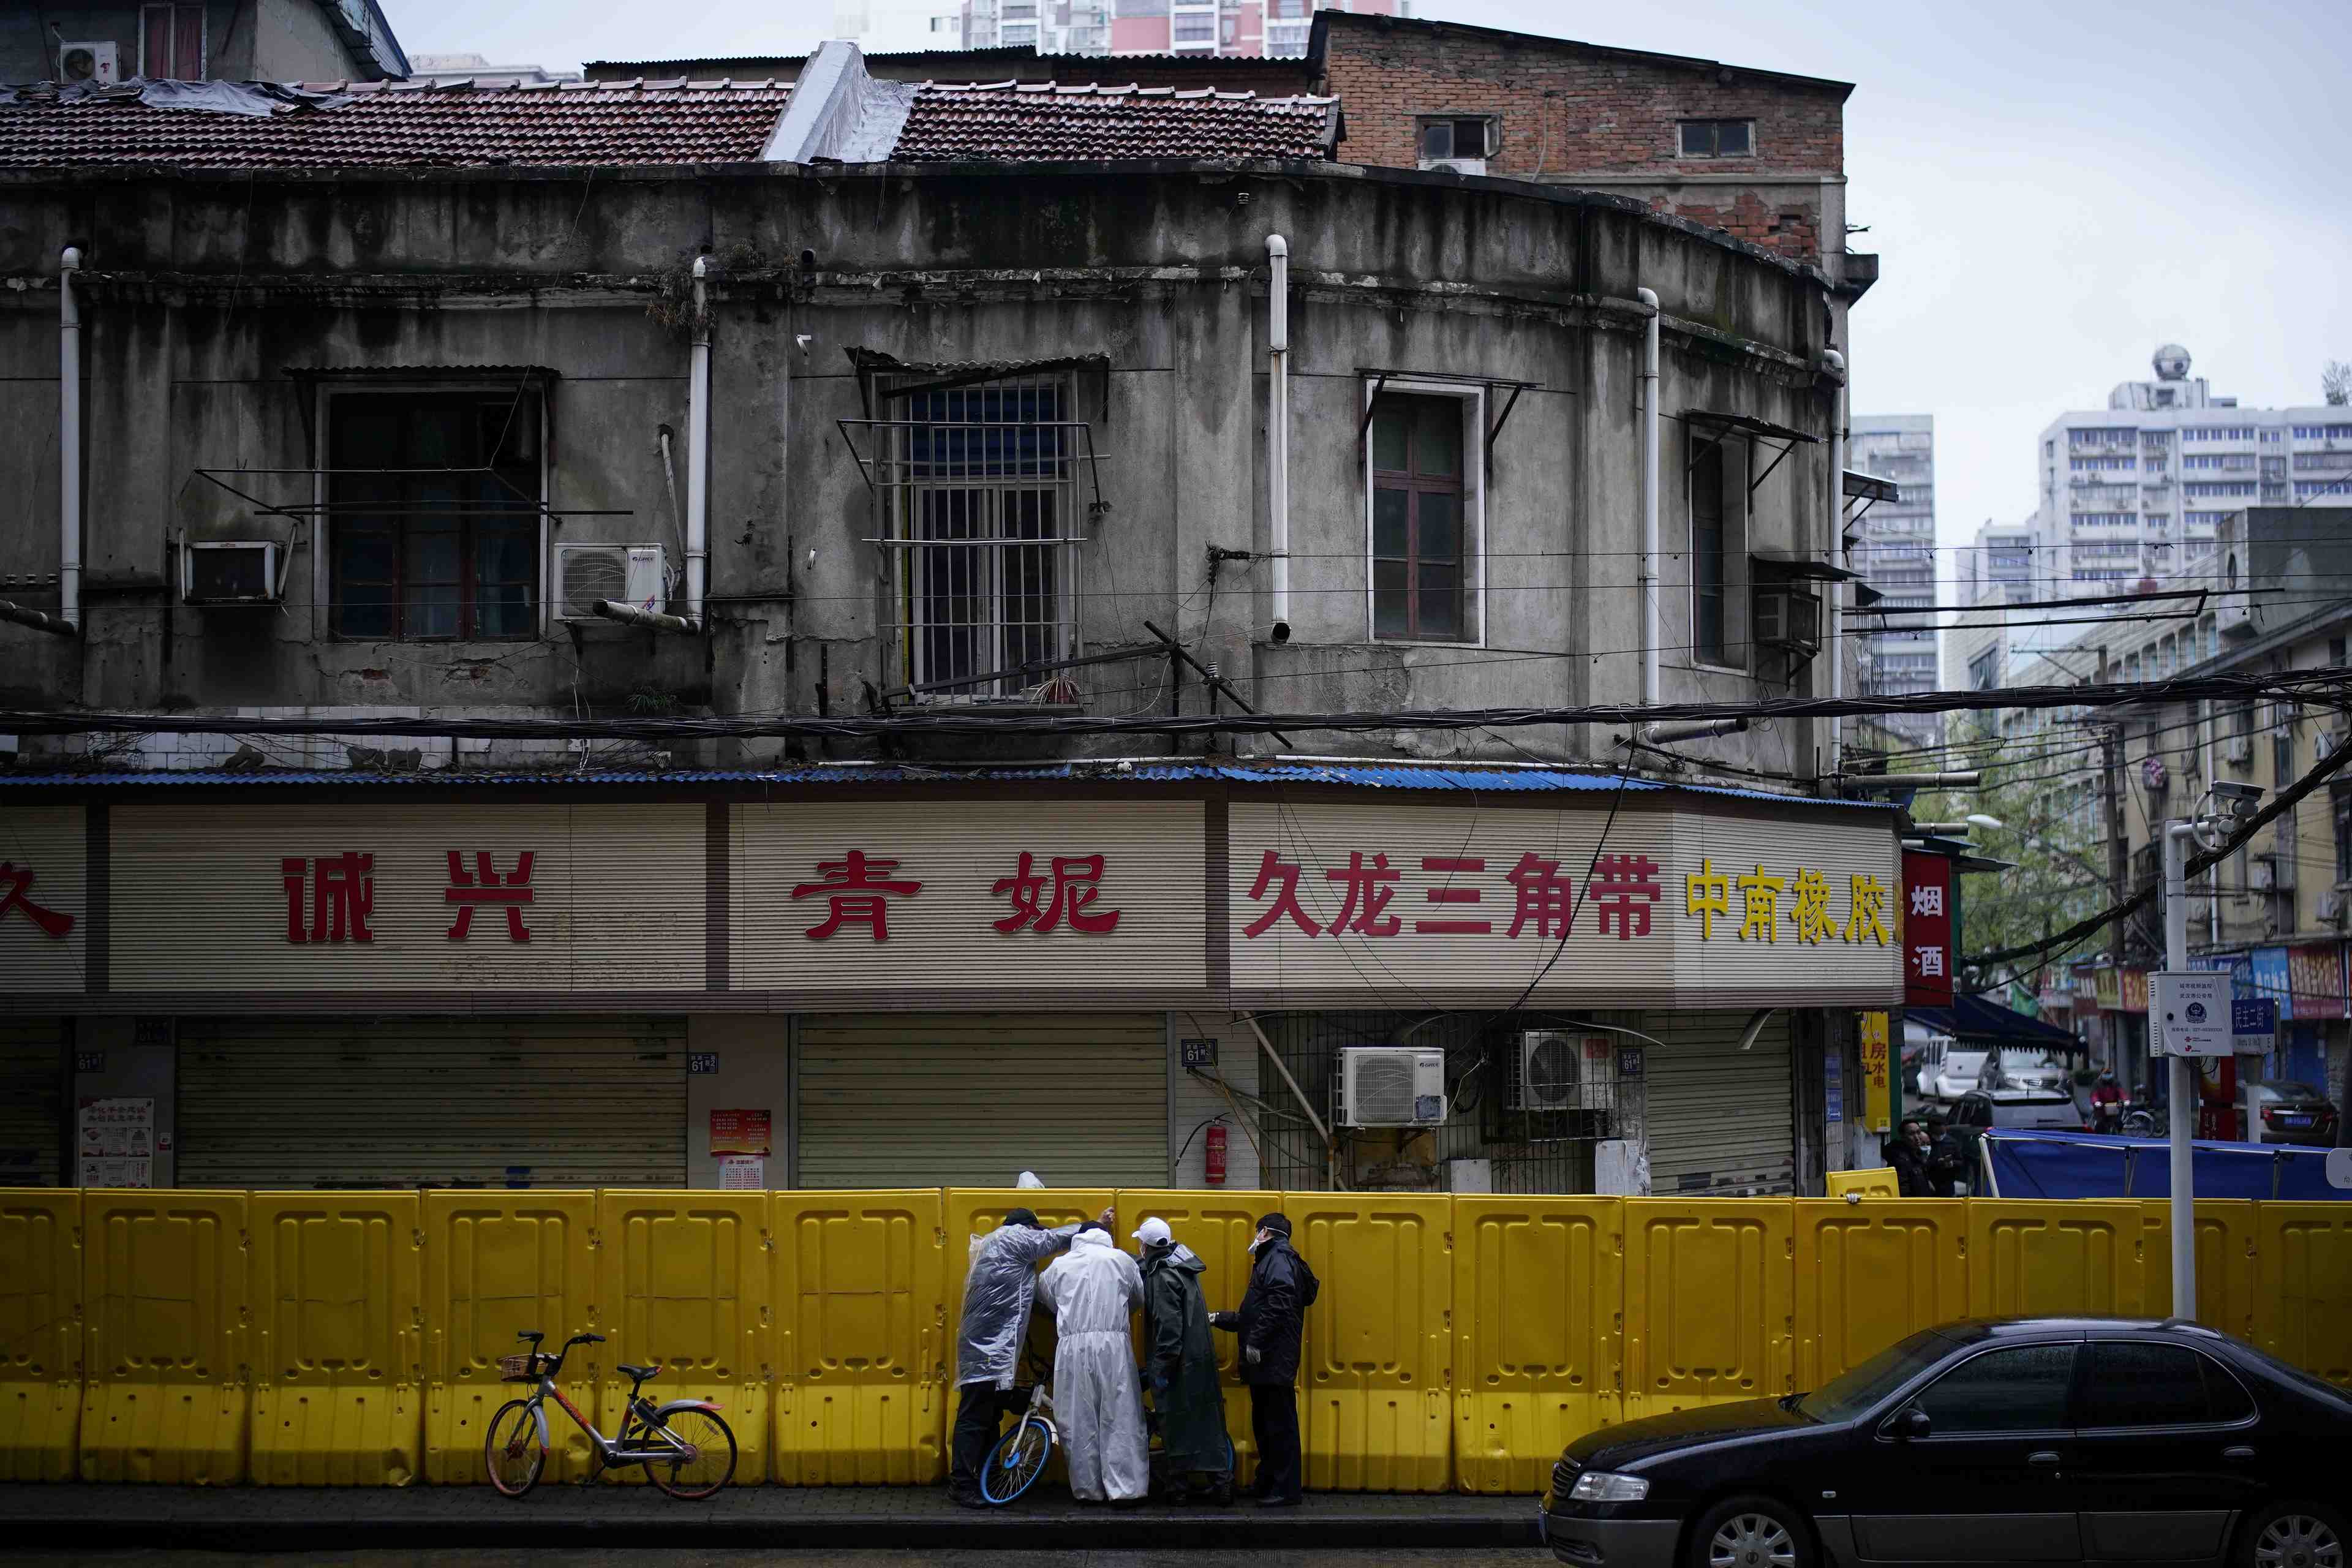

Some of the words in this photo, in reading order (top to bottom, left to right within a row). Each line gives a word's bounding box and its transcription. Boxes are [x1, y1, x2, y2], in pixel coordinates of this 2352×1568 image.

[281, 850, 537, 942] 诚兴
[790, 850, 1121, 941] 青妮
[1243, 850, 1662, 941] 久龙三角带
[1686, 858, 1890, 945] 中南橡胶
[1911, 885, 1942, 976] 烟酒
